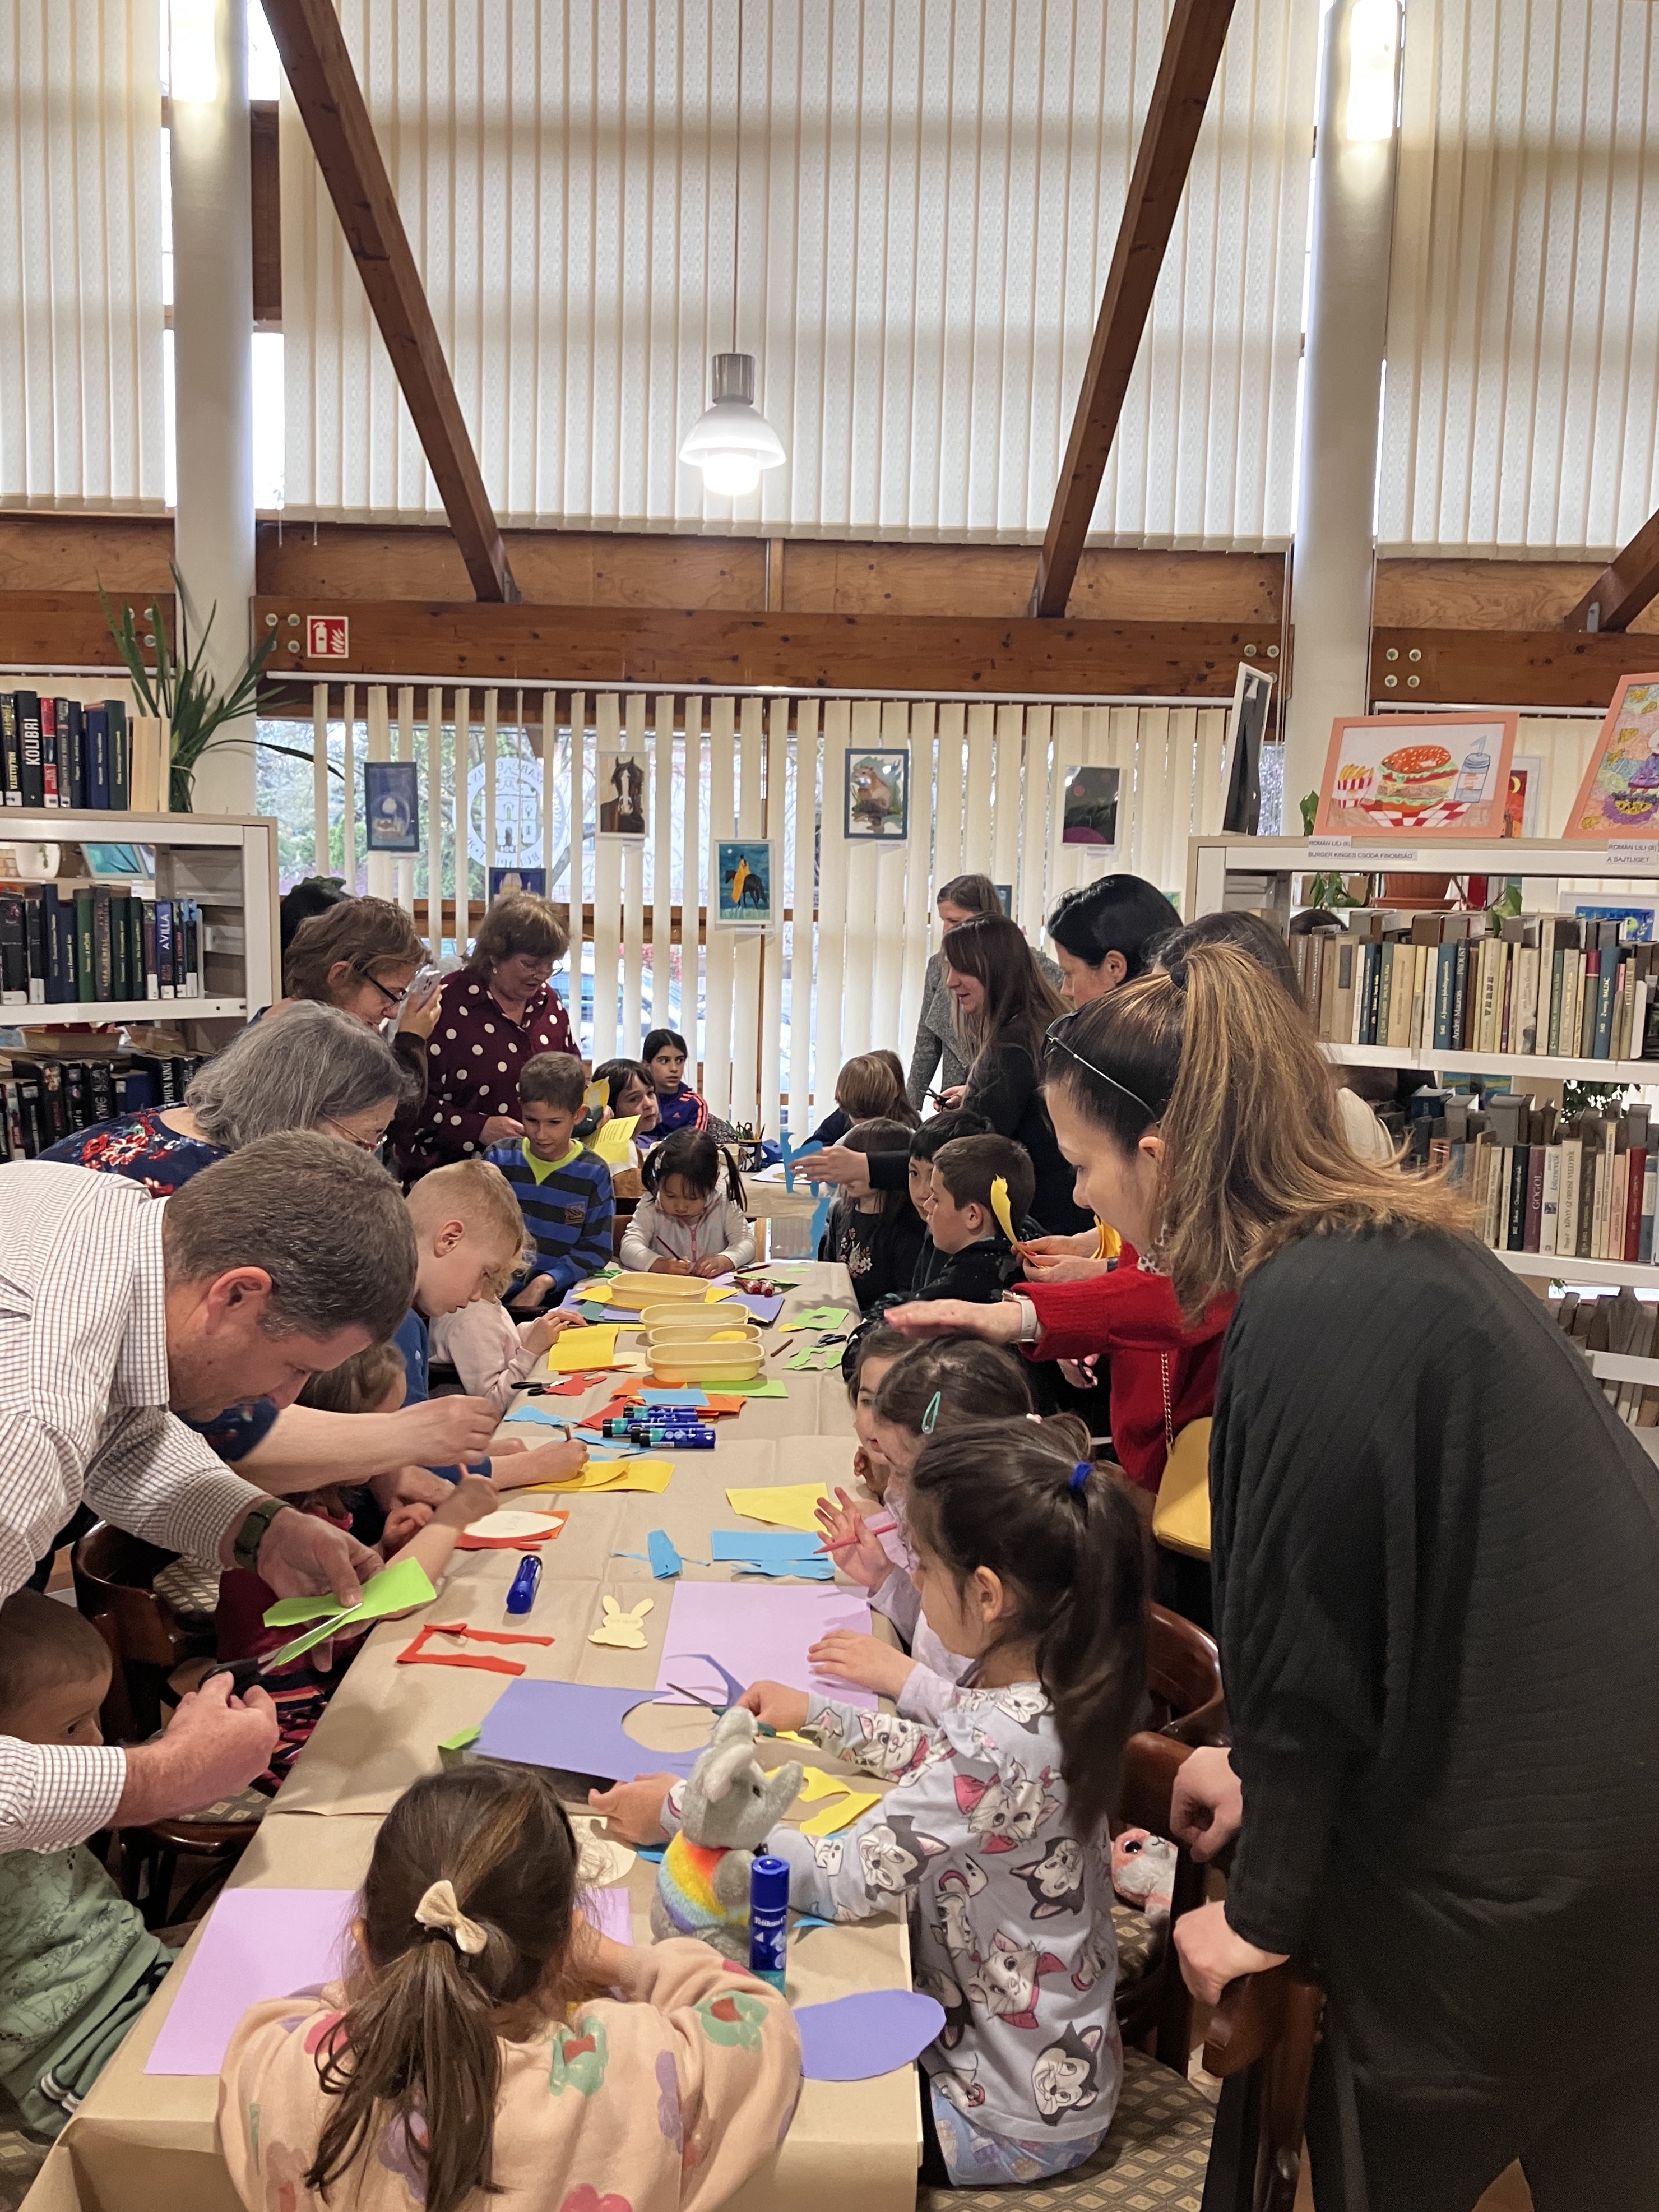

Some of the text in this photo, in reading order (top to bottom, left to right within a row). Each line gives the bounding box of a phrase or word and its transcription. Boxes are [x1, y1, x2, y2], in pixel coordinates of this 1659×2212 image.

[23, 718, 41, 766] KOLIBRI
[159, 913, 170, 943] VILLA
[1451, 946, 1466, 1040] André Maurois PROUST
[1602, 977, 1611, 998] BALZAC
[161, 1062, 173, 1081] KING
[1532, 1172, 1543, 1210] GOGOL
